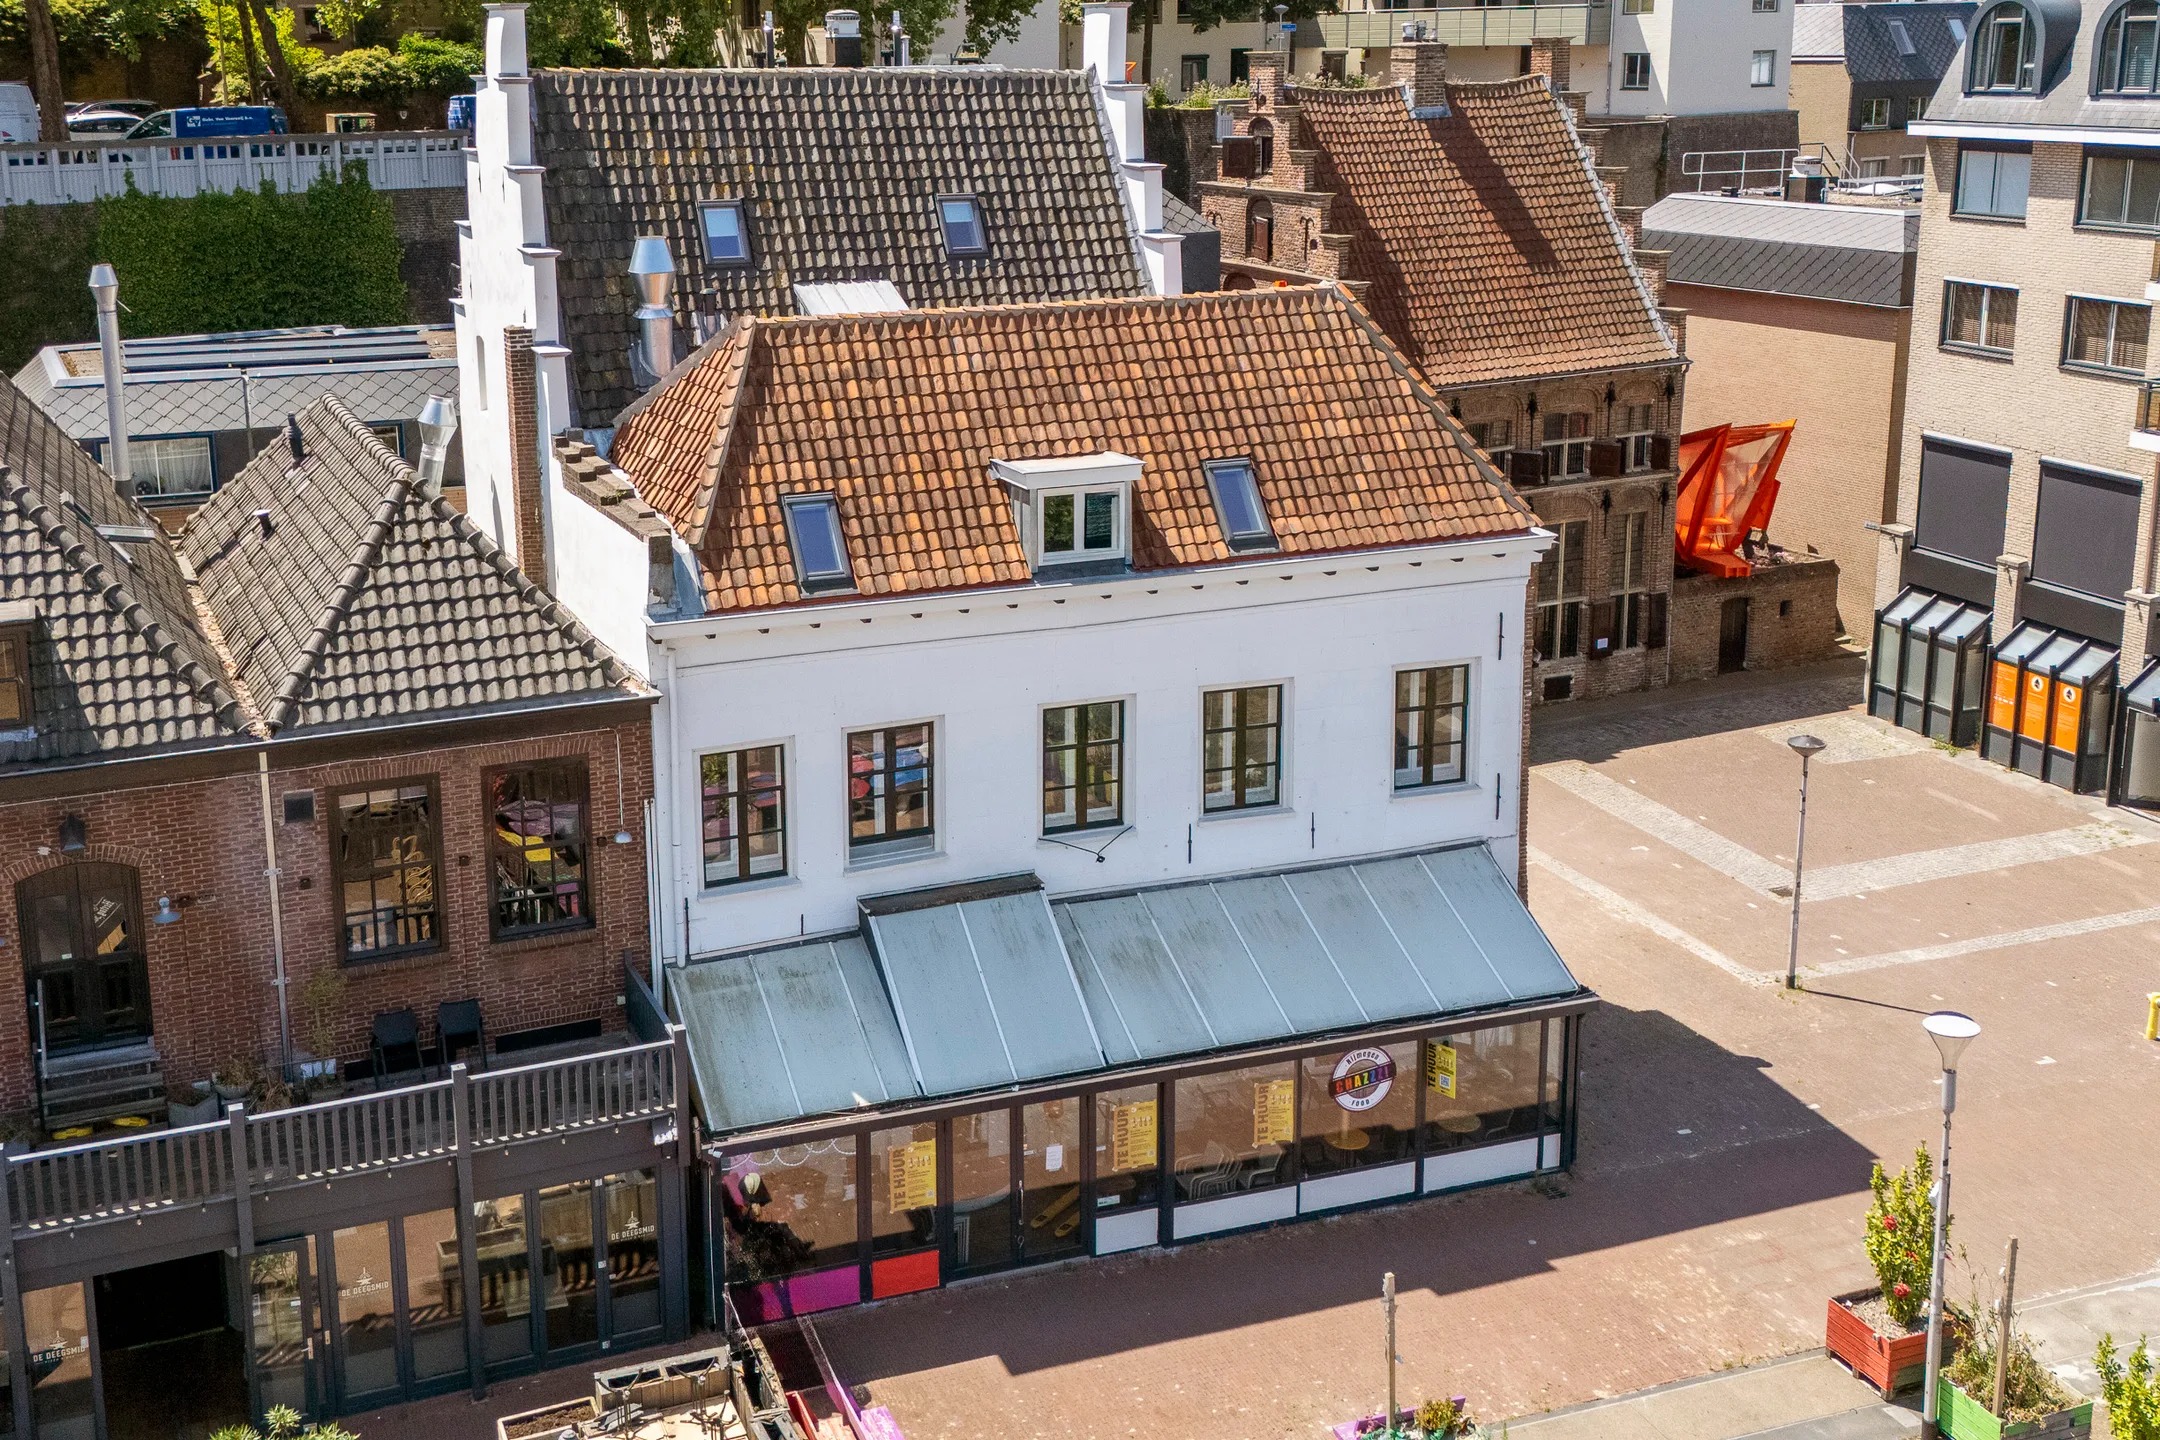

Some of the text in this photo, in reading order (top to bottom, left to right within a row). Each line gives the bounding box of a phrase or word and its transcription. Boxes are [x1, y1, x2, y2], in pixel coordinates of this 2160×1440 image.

[1346, 1051, 1380, 1065] Nijmegen
[1428, 1043, 1437, 1088] TE HUUR
[1351, 1099, 1370, 1107] FOOD
[1258, 1085, 1269, 1142] TE HUUR
[1117, 1109, 1129, 1167] TE HUUR
[893, 1148, 906, 1208] TE HUUR
[611, 1232, 620, 1240] DE
[622, 1225, 655, 1238] DEEGSMID
[341, 1289, 351, 1297] DE
[353, 1281, 389, 1294] DEEGSMID
[33, 1353, 44, 1362] DE
[46, 1346, 86, 1359] DEEGSMID
